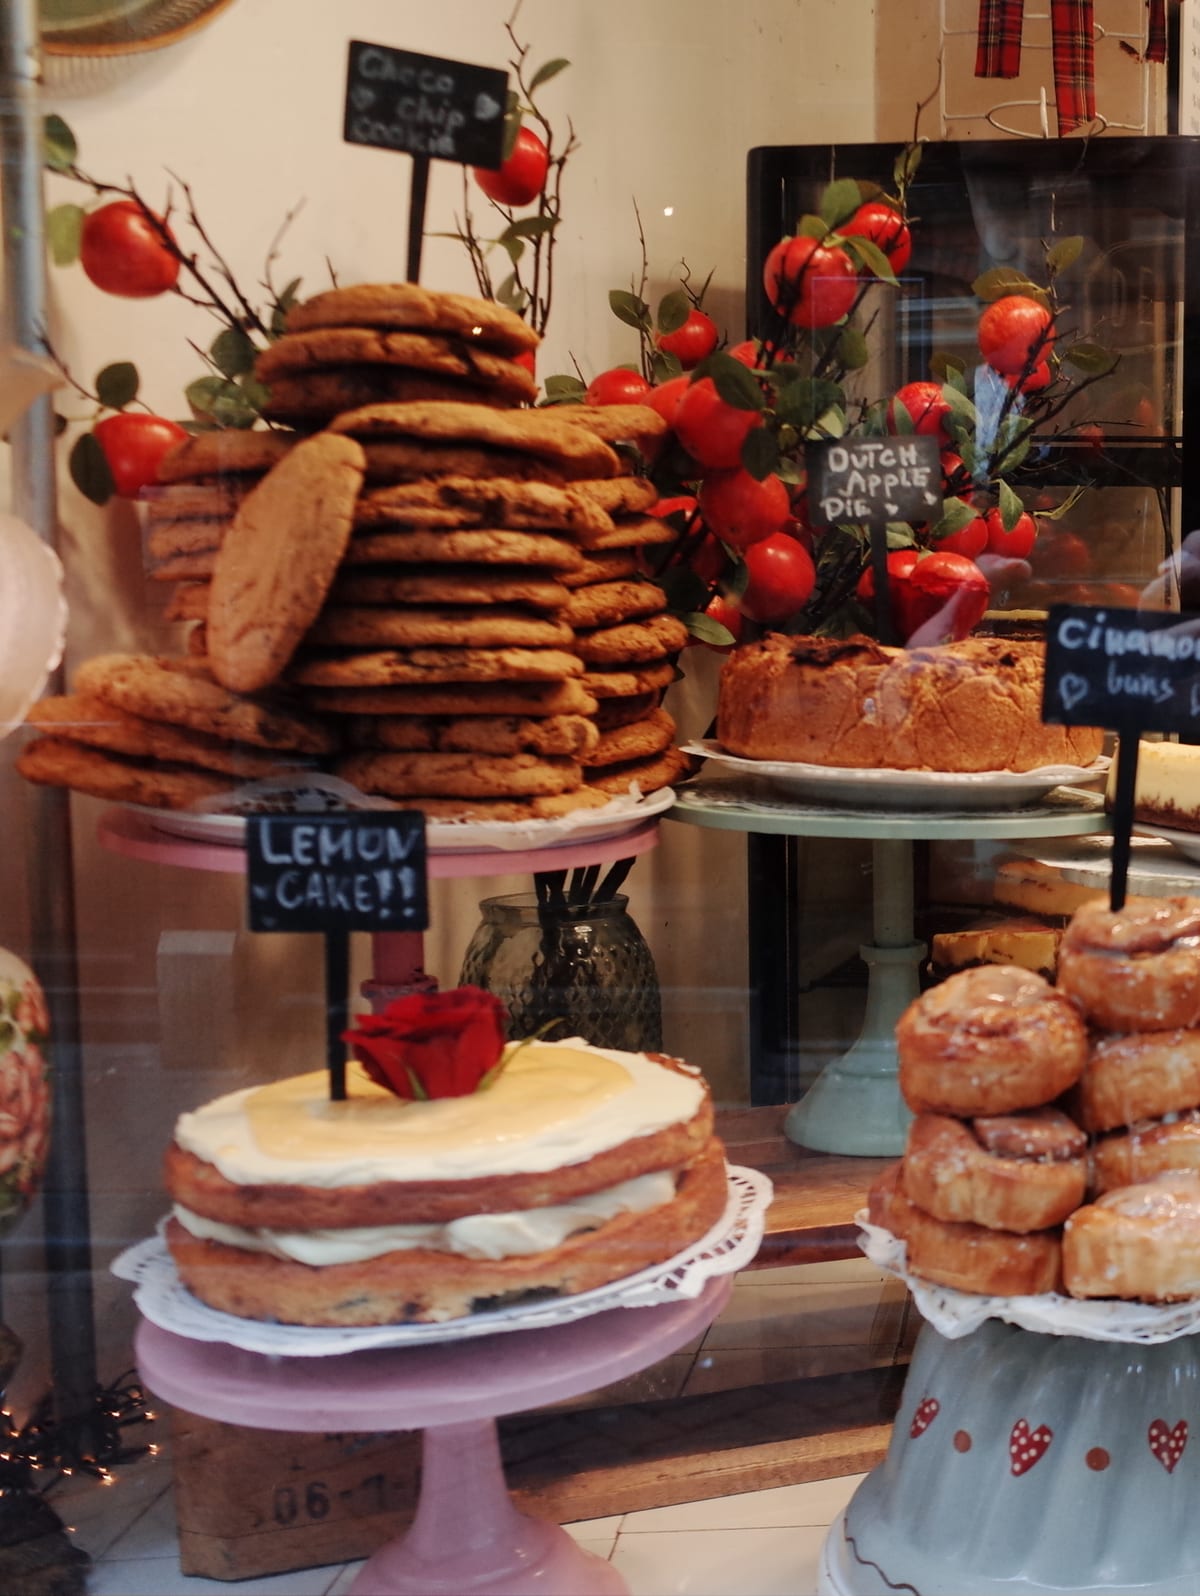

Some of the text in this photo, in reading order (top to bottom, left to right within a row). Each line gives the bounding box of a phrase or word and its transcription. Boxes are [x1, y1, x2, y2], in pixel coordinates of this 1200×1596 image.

[1107, 659, 1175, 704] buns
[260, 818, 421, 867] LEMON
[276, 866, 416, 921] CAKE!!
